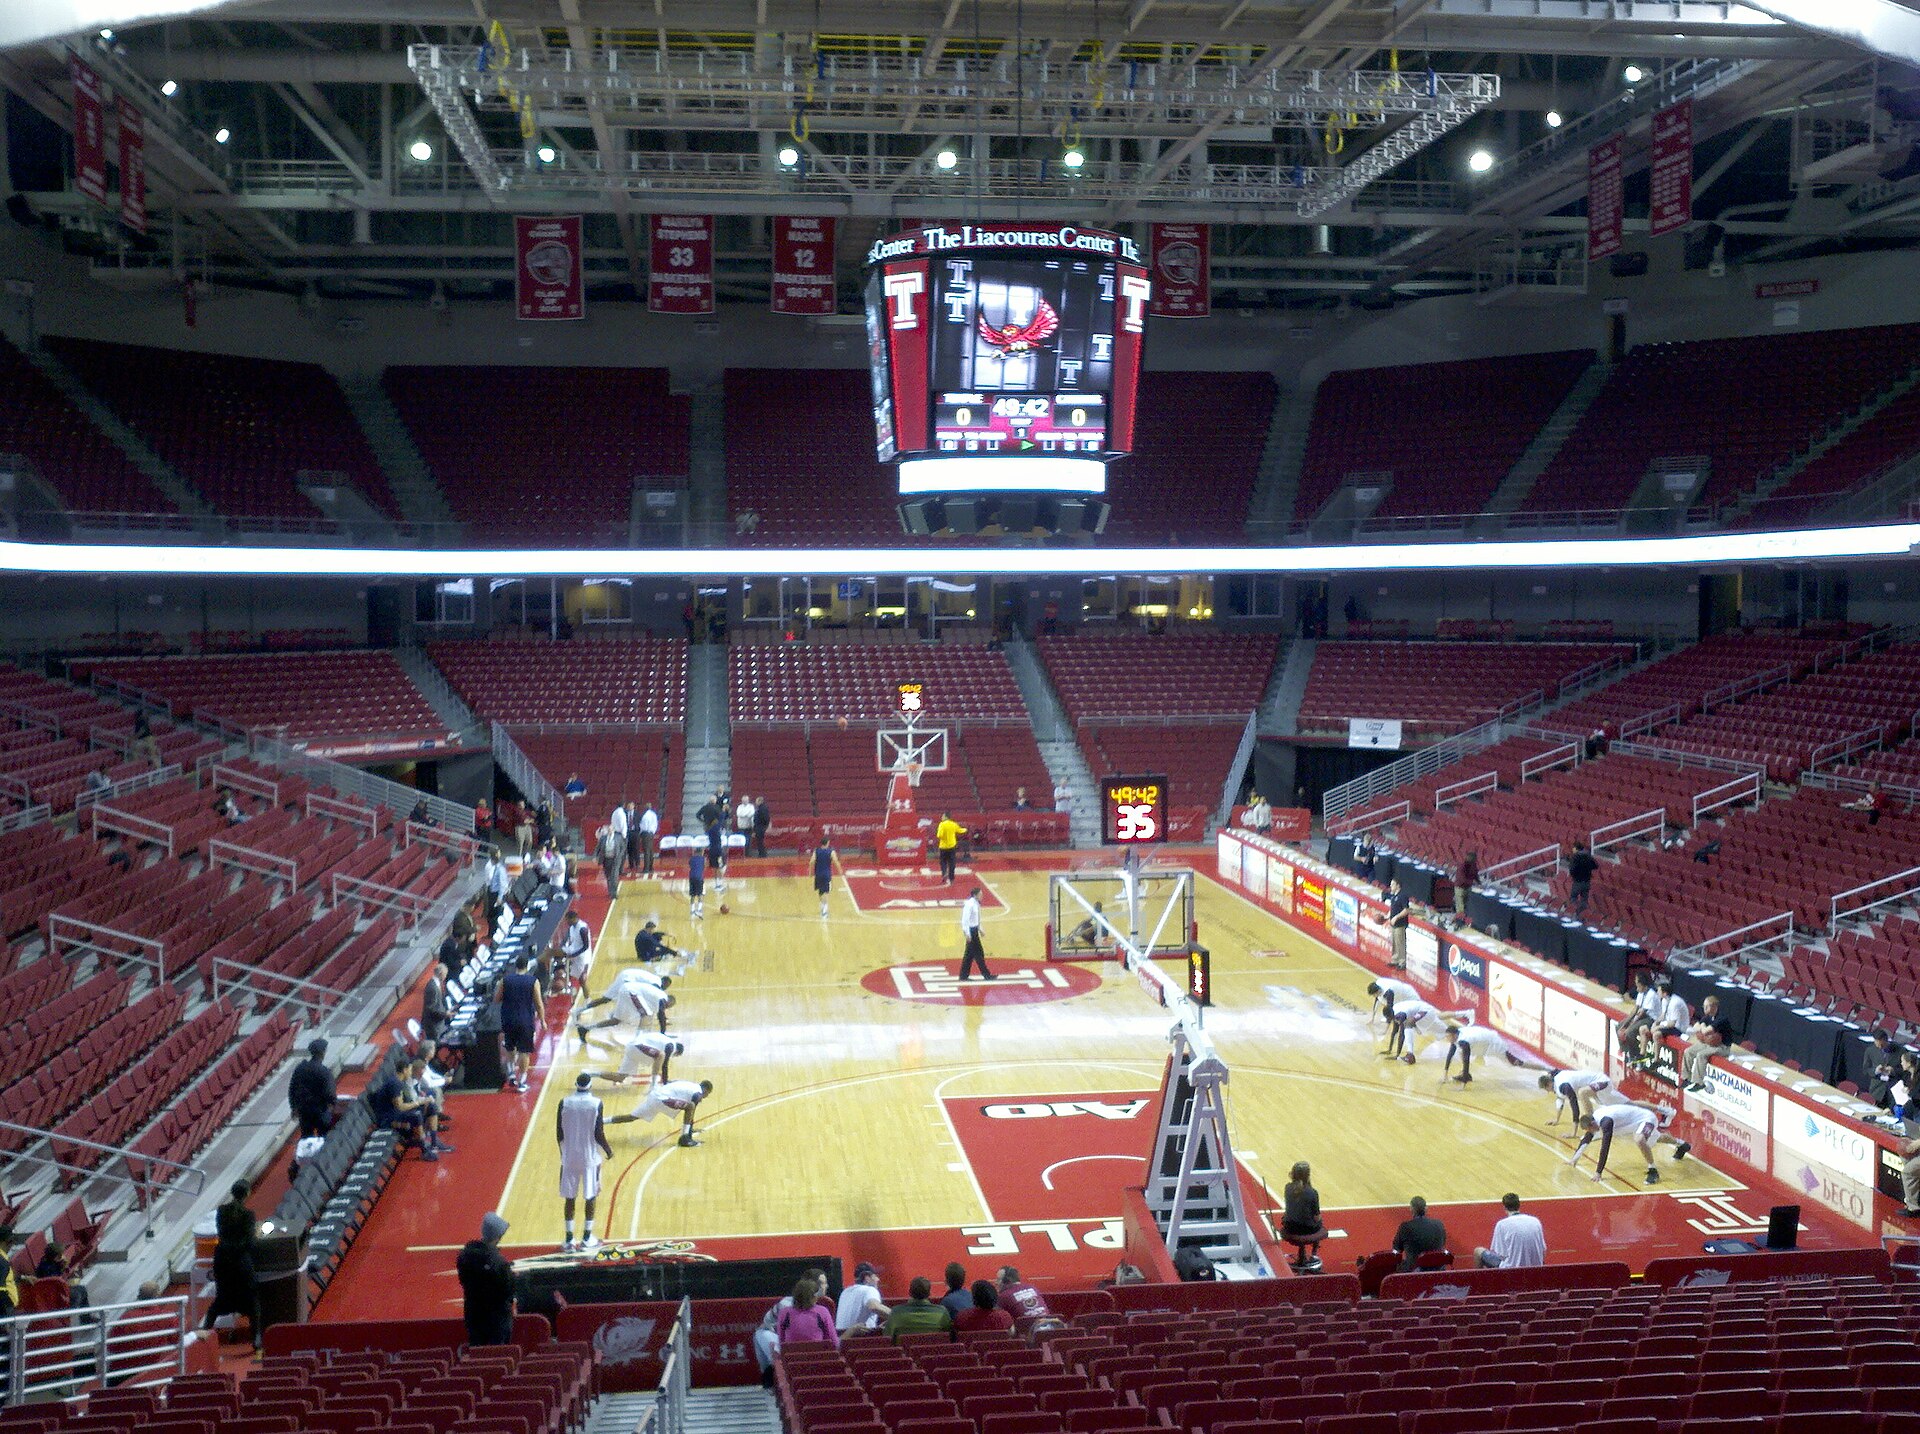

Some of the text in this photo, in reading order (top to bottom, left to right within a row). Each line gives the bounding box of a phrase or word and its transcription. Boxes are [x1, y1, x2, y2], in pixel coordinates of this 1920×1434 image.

[876, 238, 914, 260] Center
[923, 226, 1114, 254] The Liacouras Center
[670, 247, 694, 267] 33
[794, 249, 815, 268] 12
[956, 408, 971, 425] 0
[991, 398, 1050, 417] 49:42
[1071, 409, 1087, 426] 0
[1110, 785, 1158, 805] 49:42
[1117, 804, 1155, 840] 35
[1707, 1064, 1752, 1097] LANZMANN
[1716, 1088, 1752, 1112] SUBARU
[1824, 1125, 1865, 1161] PECO
[960, 1221, 1124, 1255] PLE
